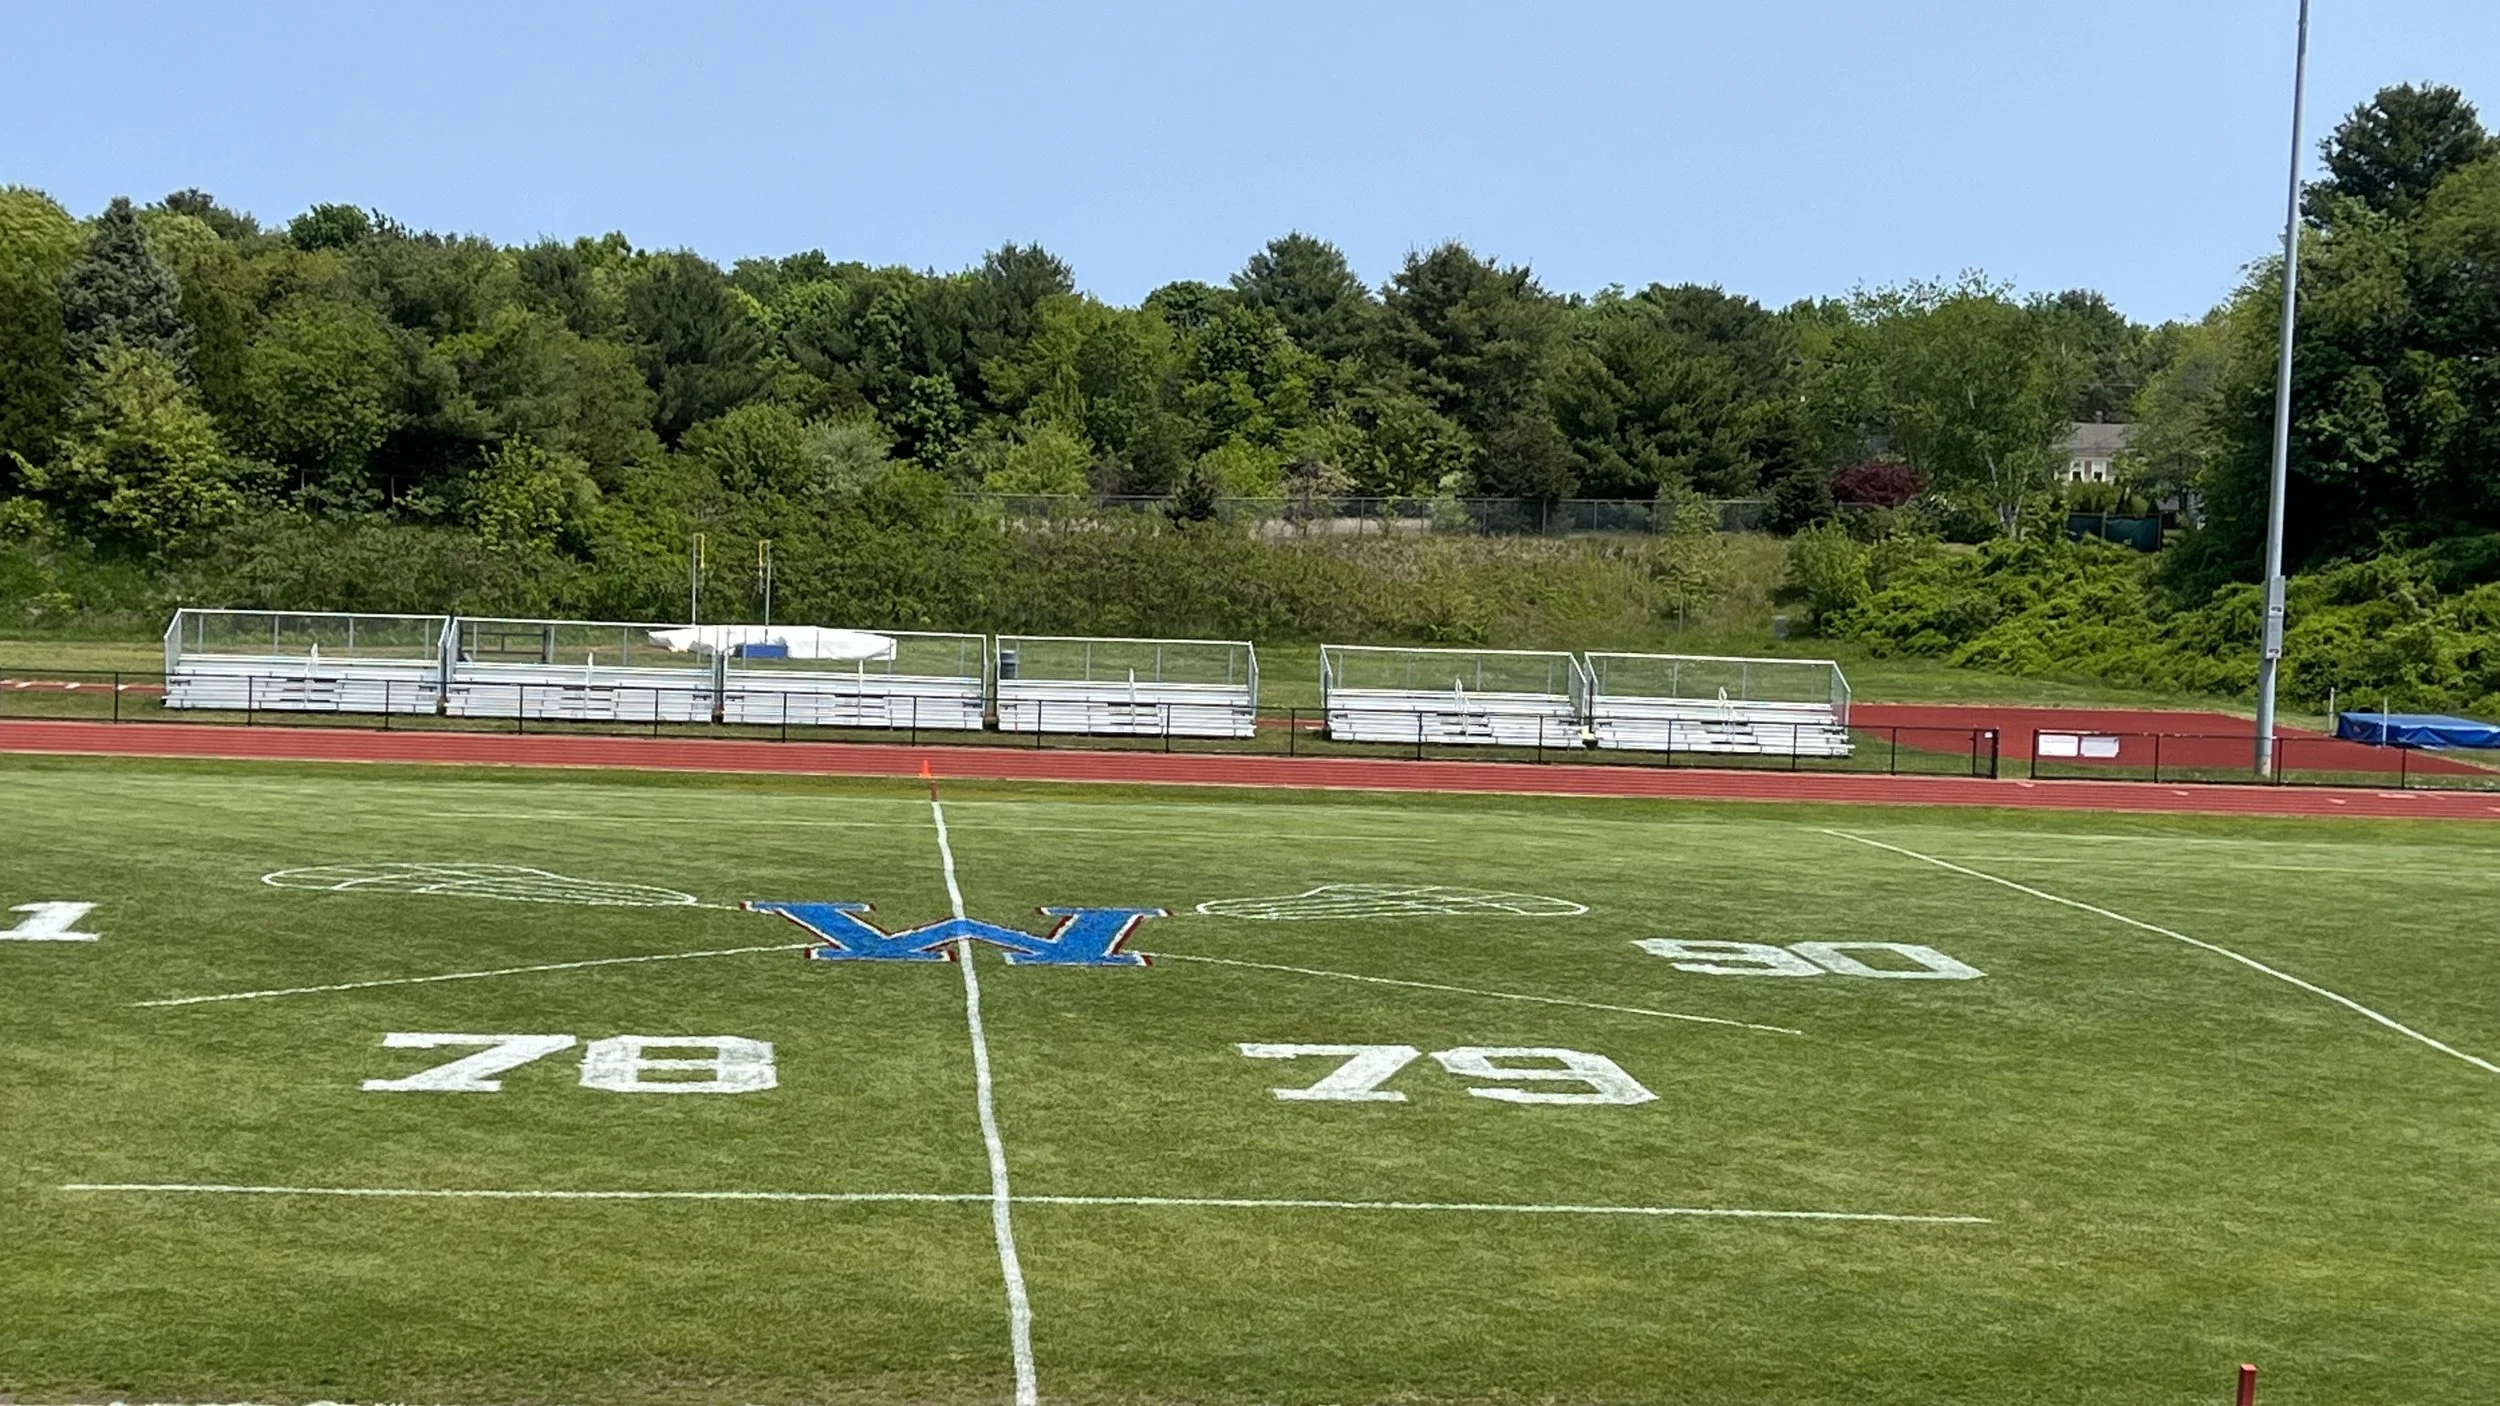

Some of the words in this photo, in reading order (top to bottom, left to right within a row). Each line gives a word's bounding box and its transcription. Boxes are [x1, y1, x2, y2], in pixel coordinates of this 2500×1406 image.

[1632, 938, 1986, 979] 90
[363, 1033, 778, 1094] 78
[1239, 1043, 1659, 1105] 79
